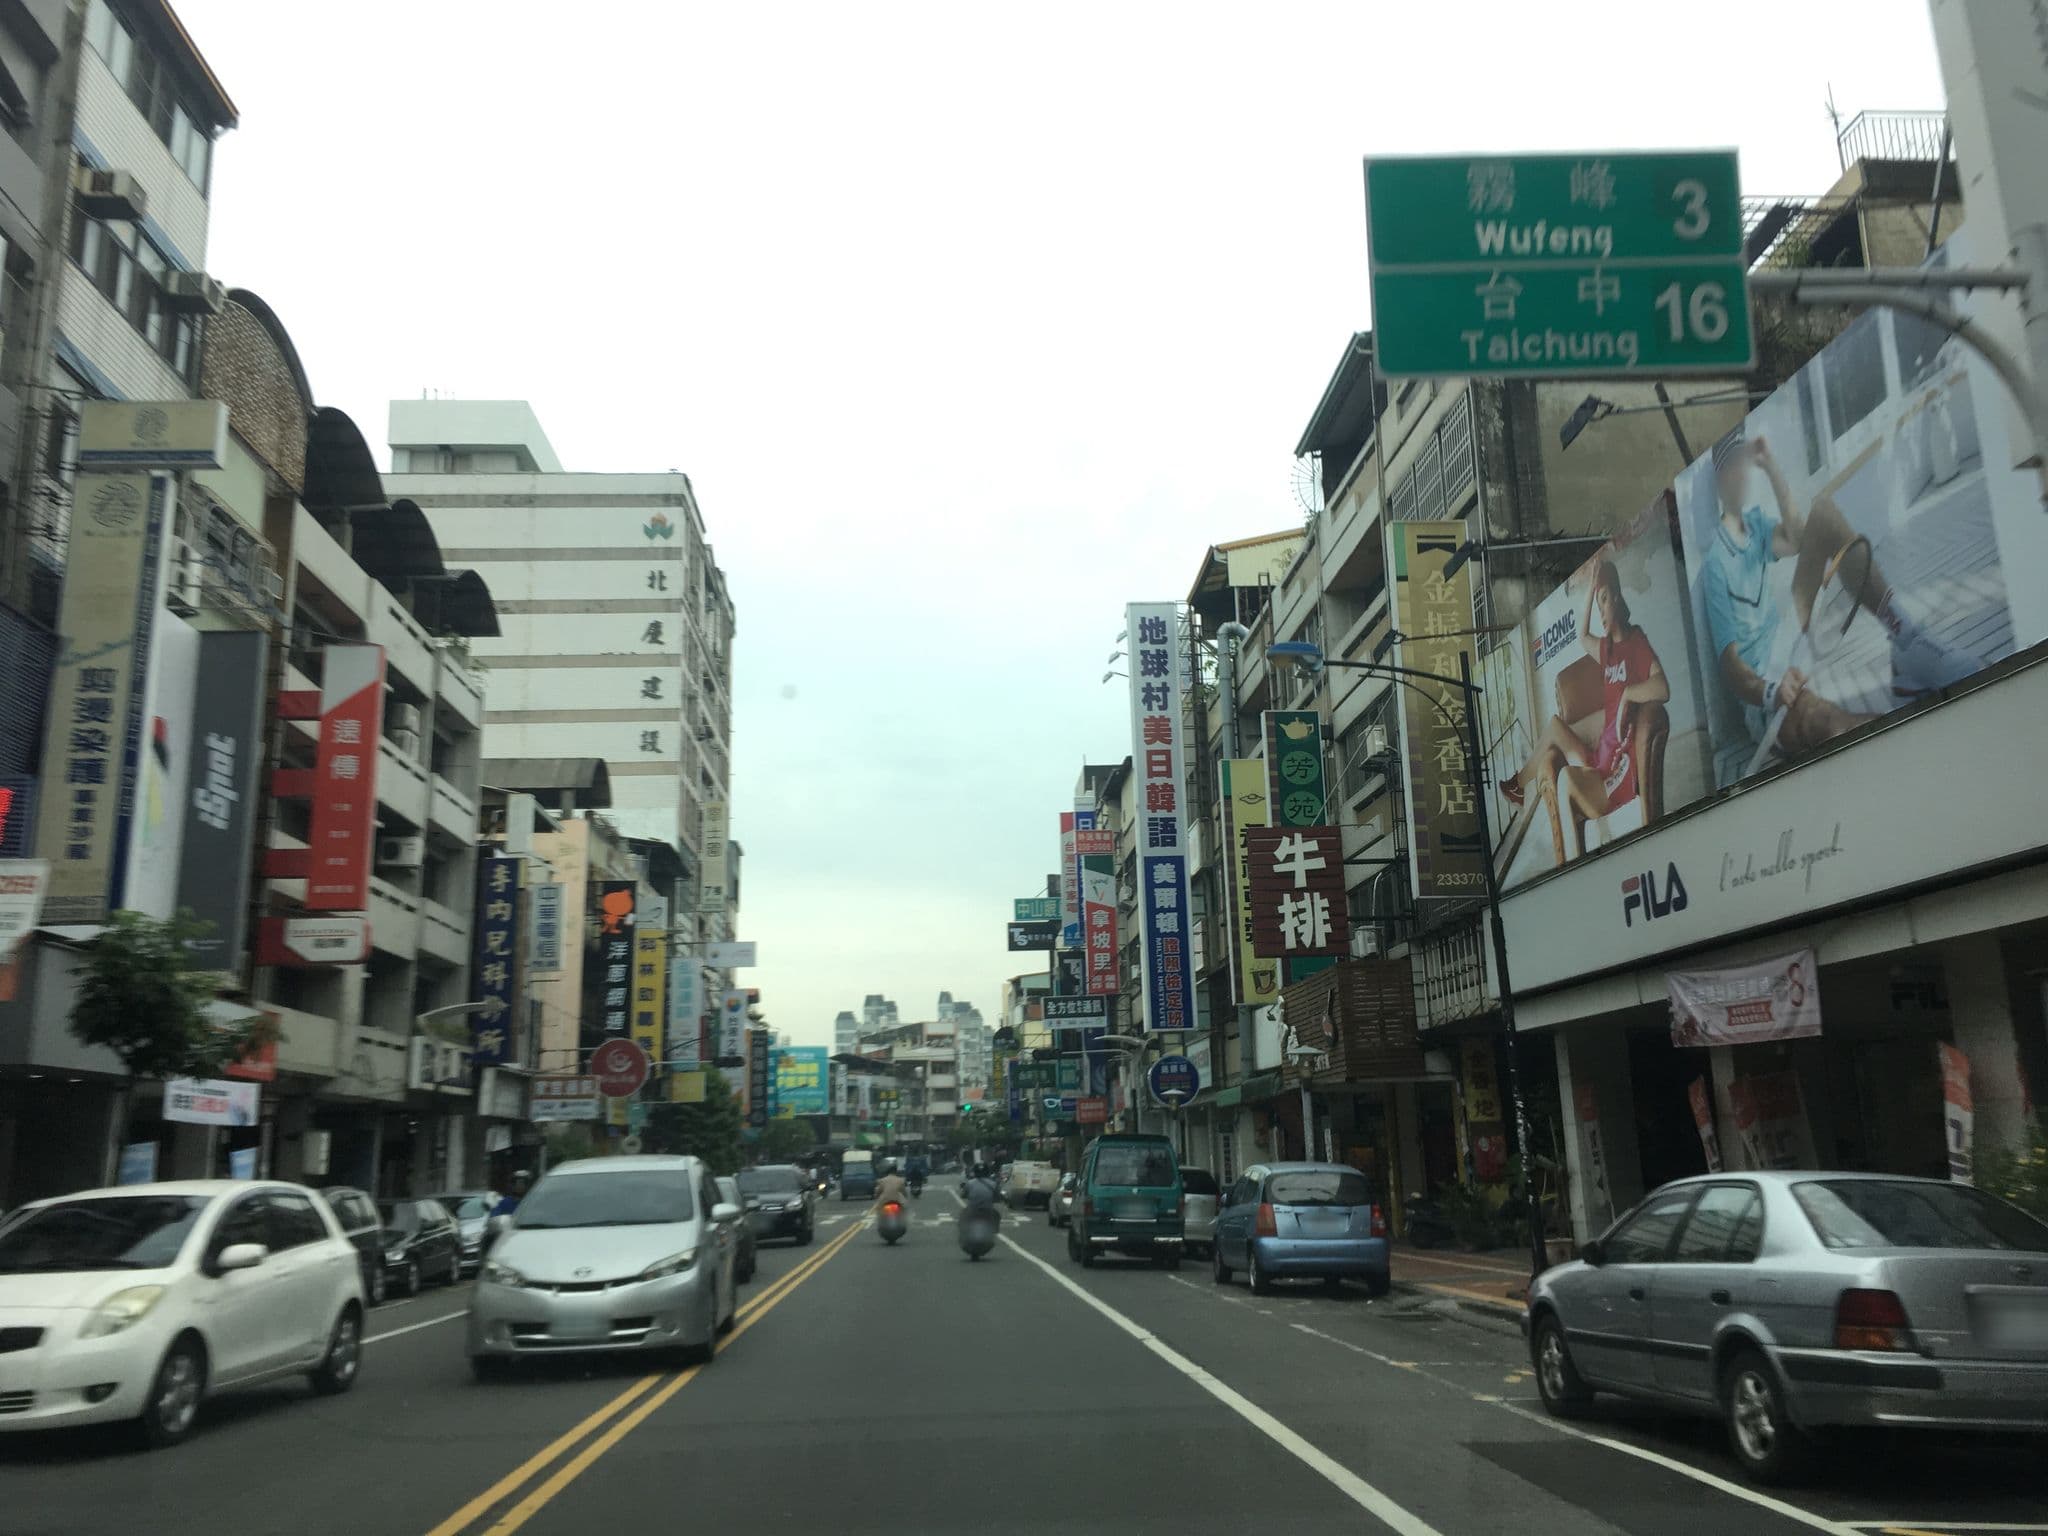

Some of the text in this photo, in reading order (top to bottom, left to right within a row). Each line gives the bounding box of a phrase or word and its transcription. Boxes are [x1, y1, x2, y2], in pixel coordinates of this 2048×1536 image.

[1466, 160, 1617, 214] 霧峰
[1671, 178, 1711, 240] 3
[1474, 218, 1614, 257] Wufeng
[1474, 266, 1621, 321] 台中
[1654, 280, 1730, 343] 16
[1460, 327, 1640, 369] Taichung
[1542, 608, 1576, 650] ICONIC
[1286, 756, 1318, 820] 芳苑
[1273, 832, 1333, 949] 牛排
[1621, 861, 1688, 928] FILA
[1155, 937, 1164, 973] MILTON
